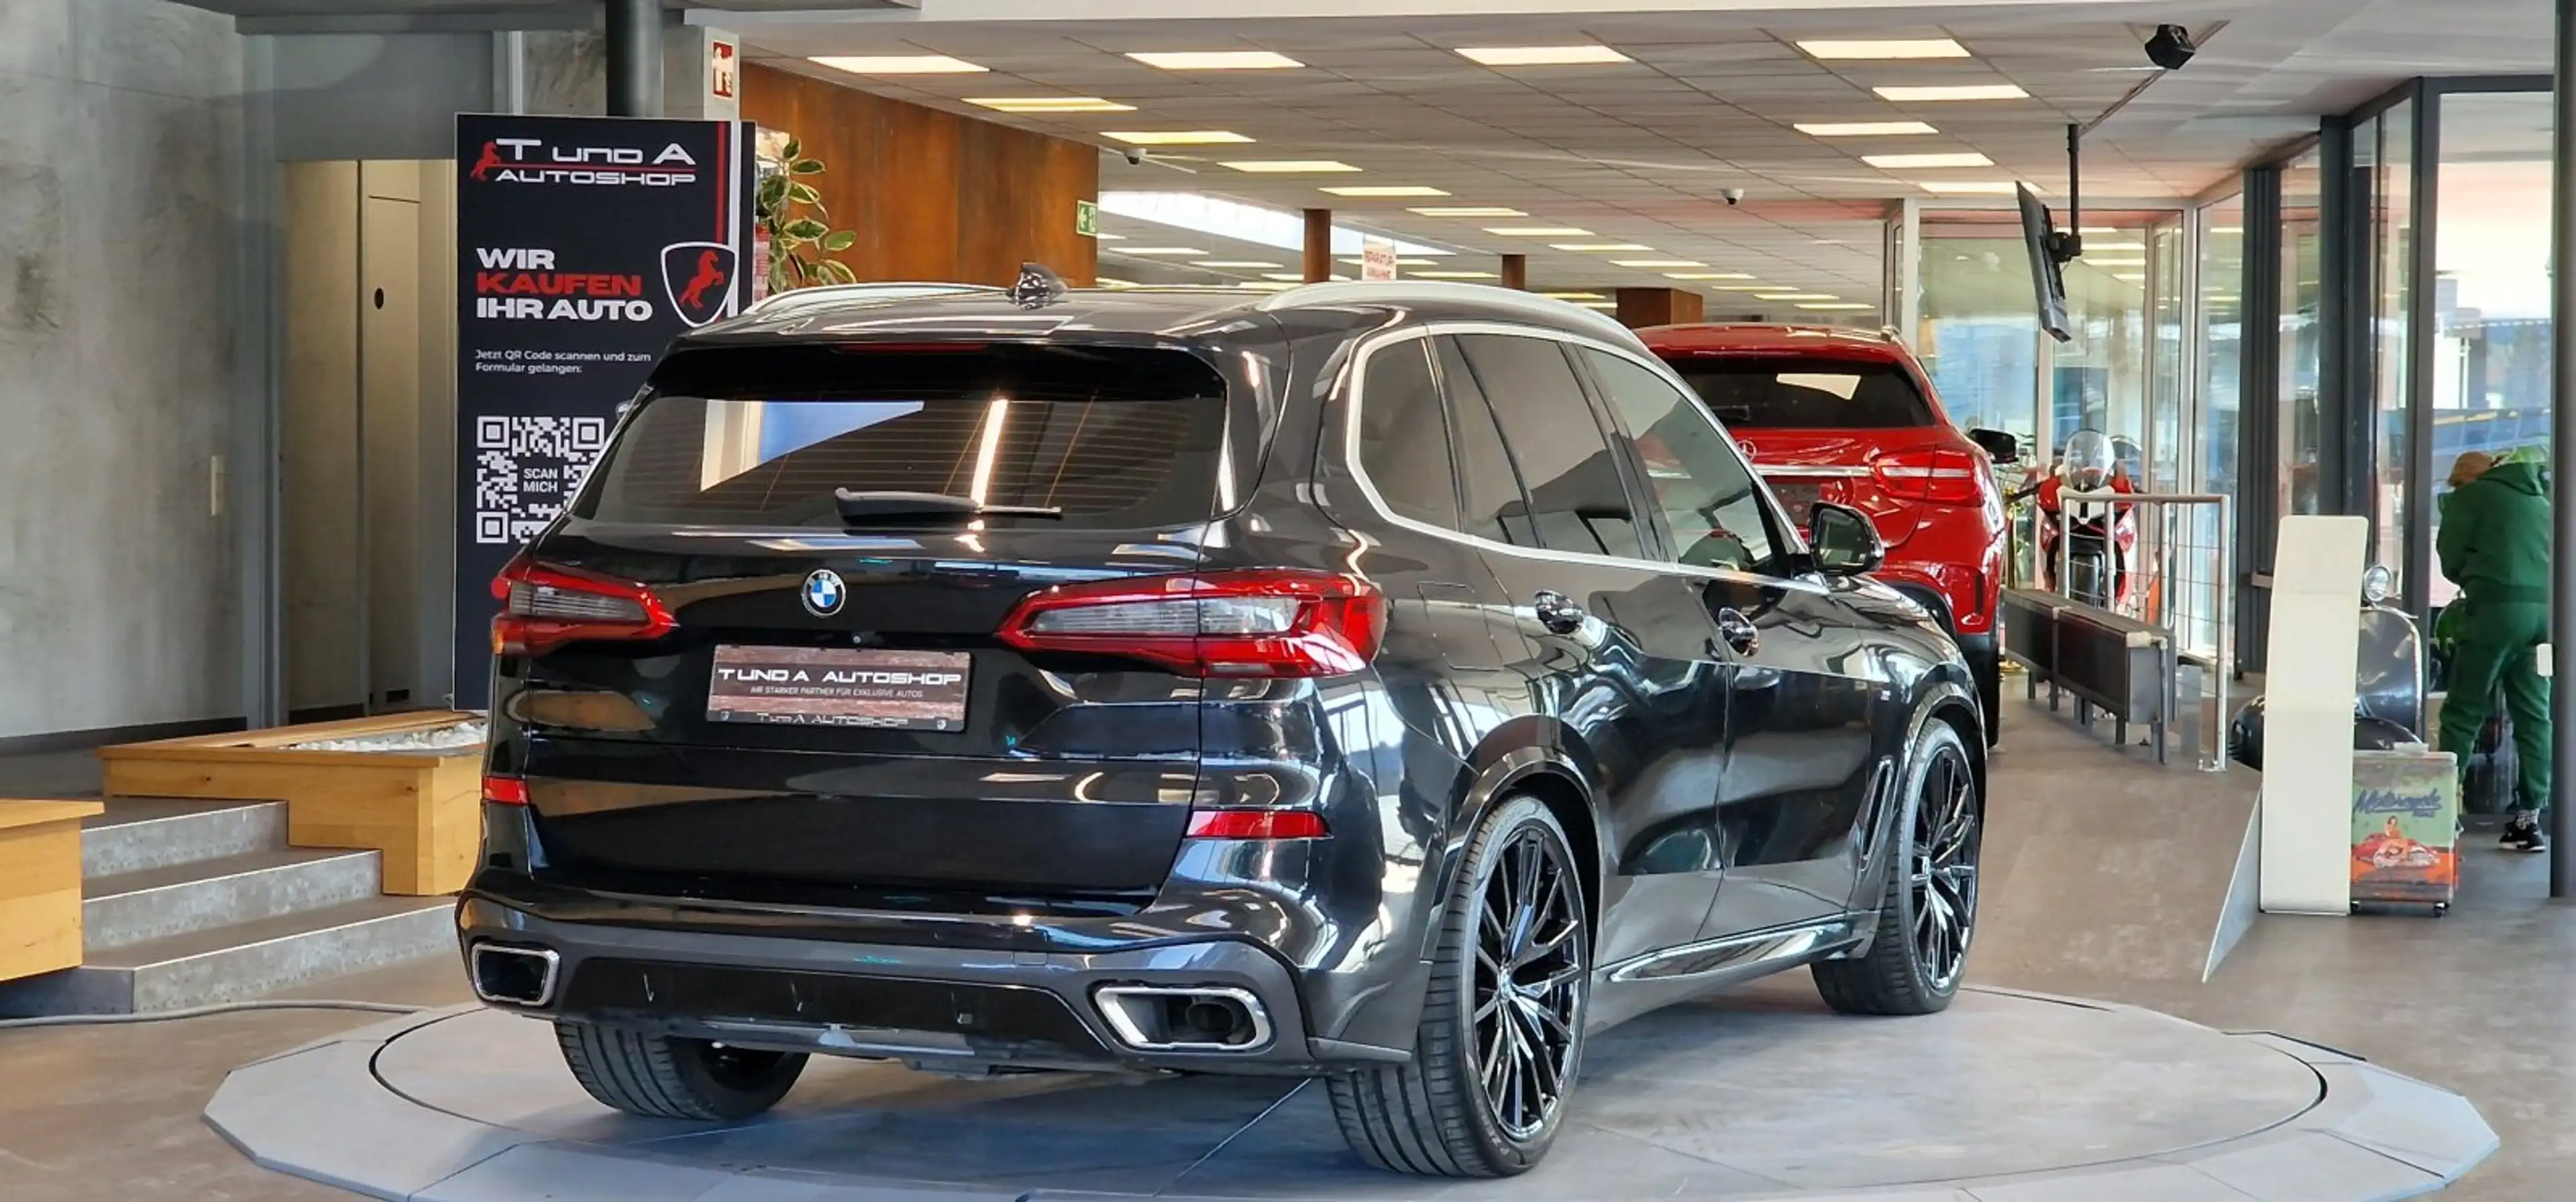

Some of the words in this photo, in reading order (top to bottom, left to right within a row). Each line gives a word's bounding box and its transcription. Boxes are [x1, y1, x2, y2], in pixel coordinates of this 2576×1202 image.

[495, 138, 542, 161] T
[651, 143, 696, 165] A
[495, 169, 696, 186] AUTOSHOP
[477, 248, 555, 270] WIR
[477, 272, 642, 296] KAUFEN
[477, 298, 543, 319] IHR
[547, 299, 653, 321] AUTO
[476, 349, 502, 360] Jetzt
[504, 350, 522, 360] QR
[524, 350, 552, 360] Code
[554, 351, 600, 361] scannen
[603, 351, 625, 362] und
[627, 354, 651, 362] zum
[476, 363, 525, 372] Formular
[528, 364, 582, 375] gelangen:
[523, 469, 557, 479] SCAN
[523, 481, 557, 492] MICH
[822, 671, 961, 686] AUTOSHOP
[800, 688, 835, 696] PARTNER
[853, 688, 895, 698] EXKLUSIVE
[896, 690, 924, 698] AUTOS
